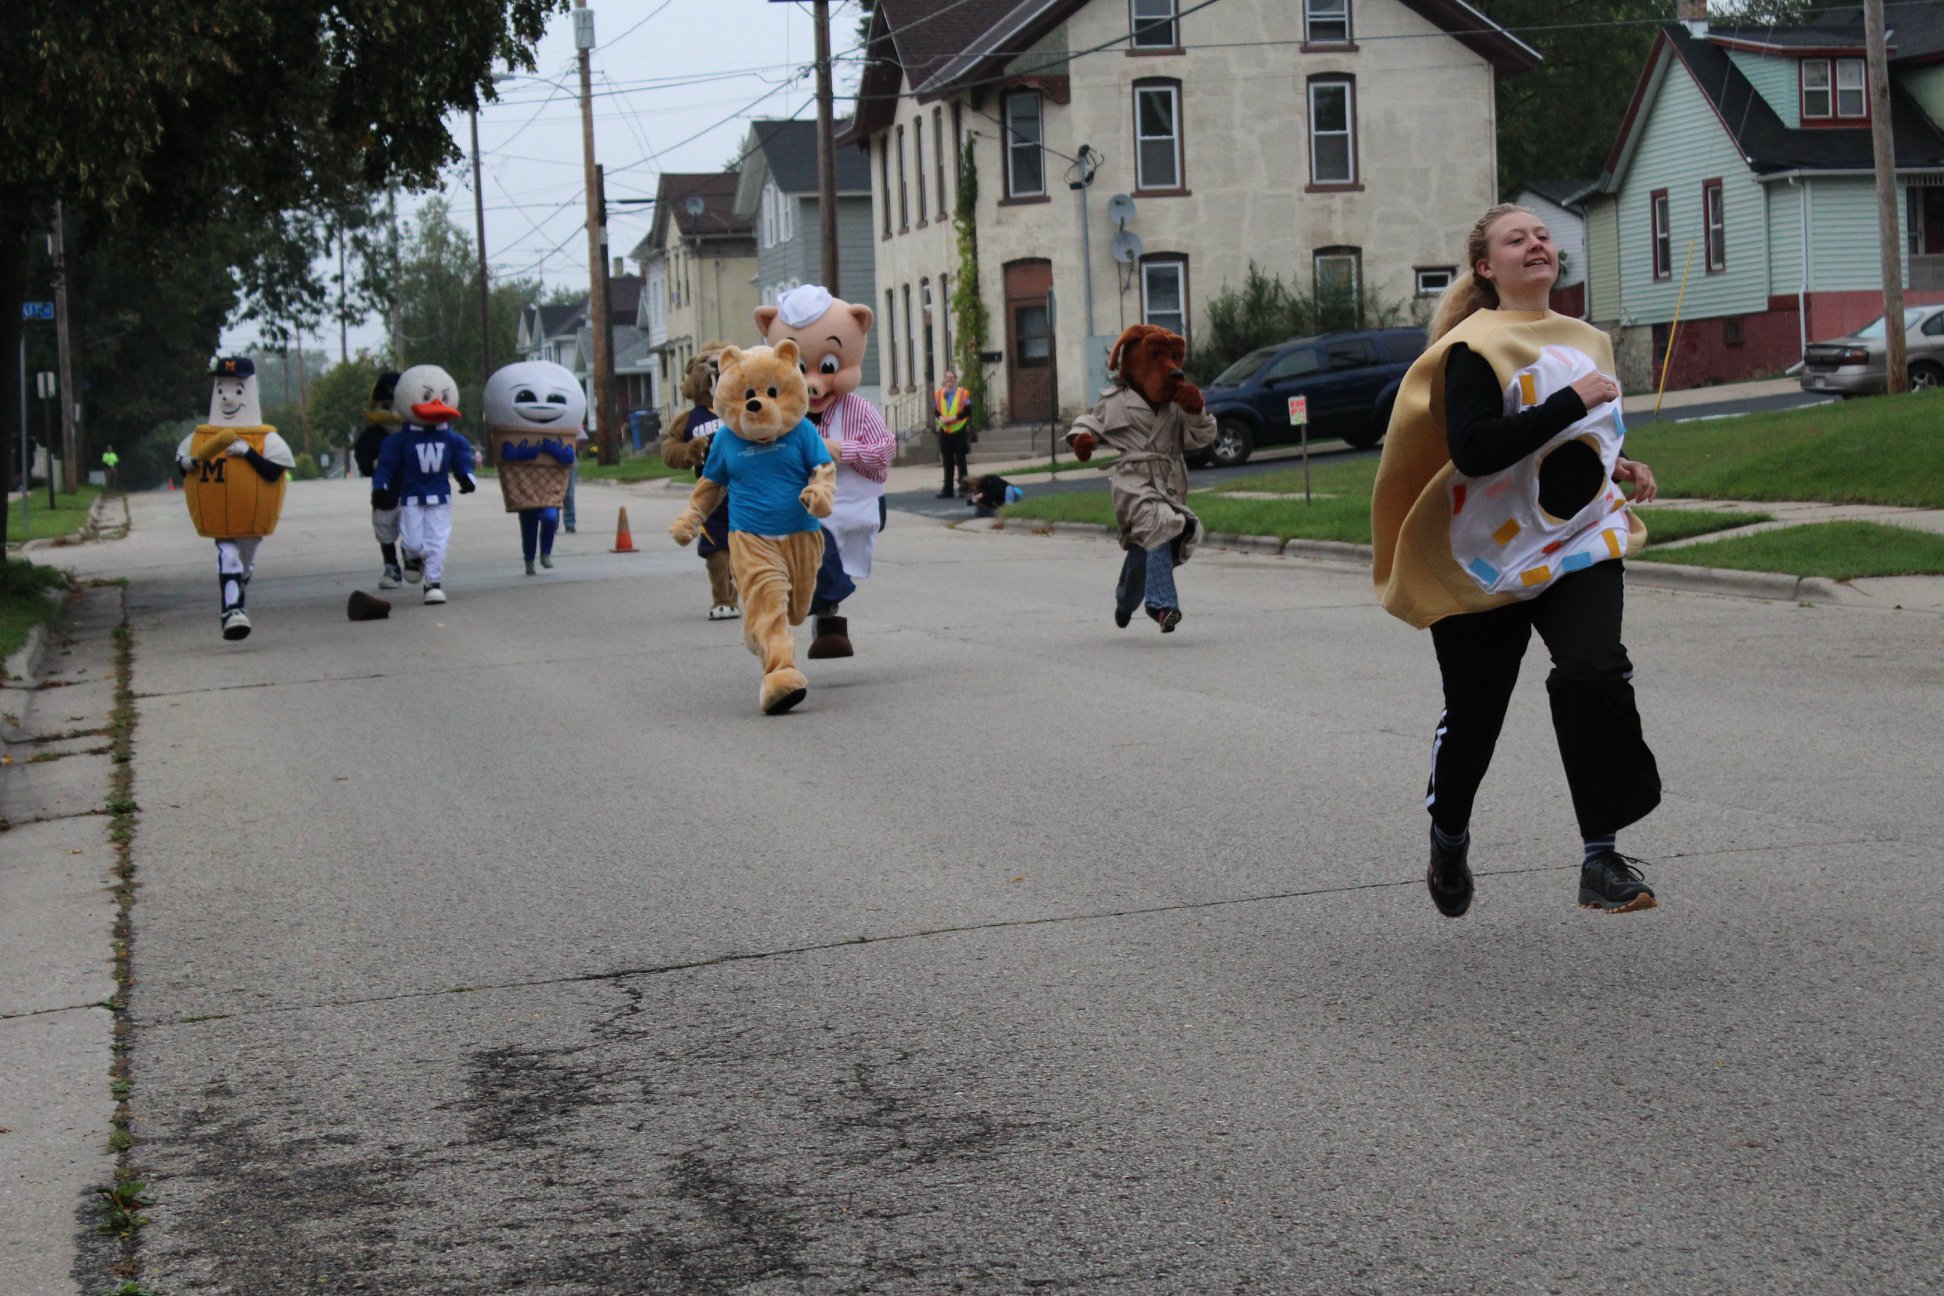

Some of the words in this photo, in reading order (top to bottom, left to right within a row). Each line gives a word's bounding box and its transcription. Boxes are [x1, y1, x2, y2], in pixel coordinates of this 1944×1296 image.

[224, 361, 236, 372] M
[415, 442, 445, 473] W
[200, 458, 226, 483] M
